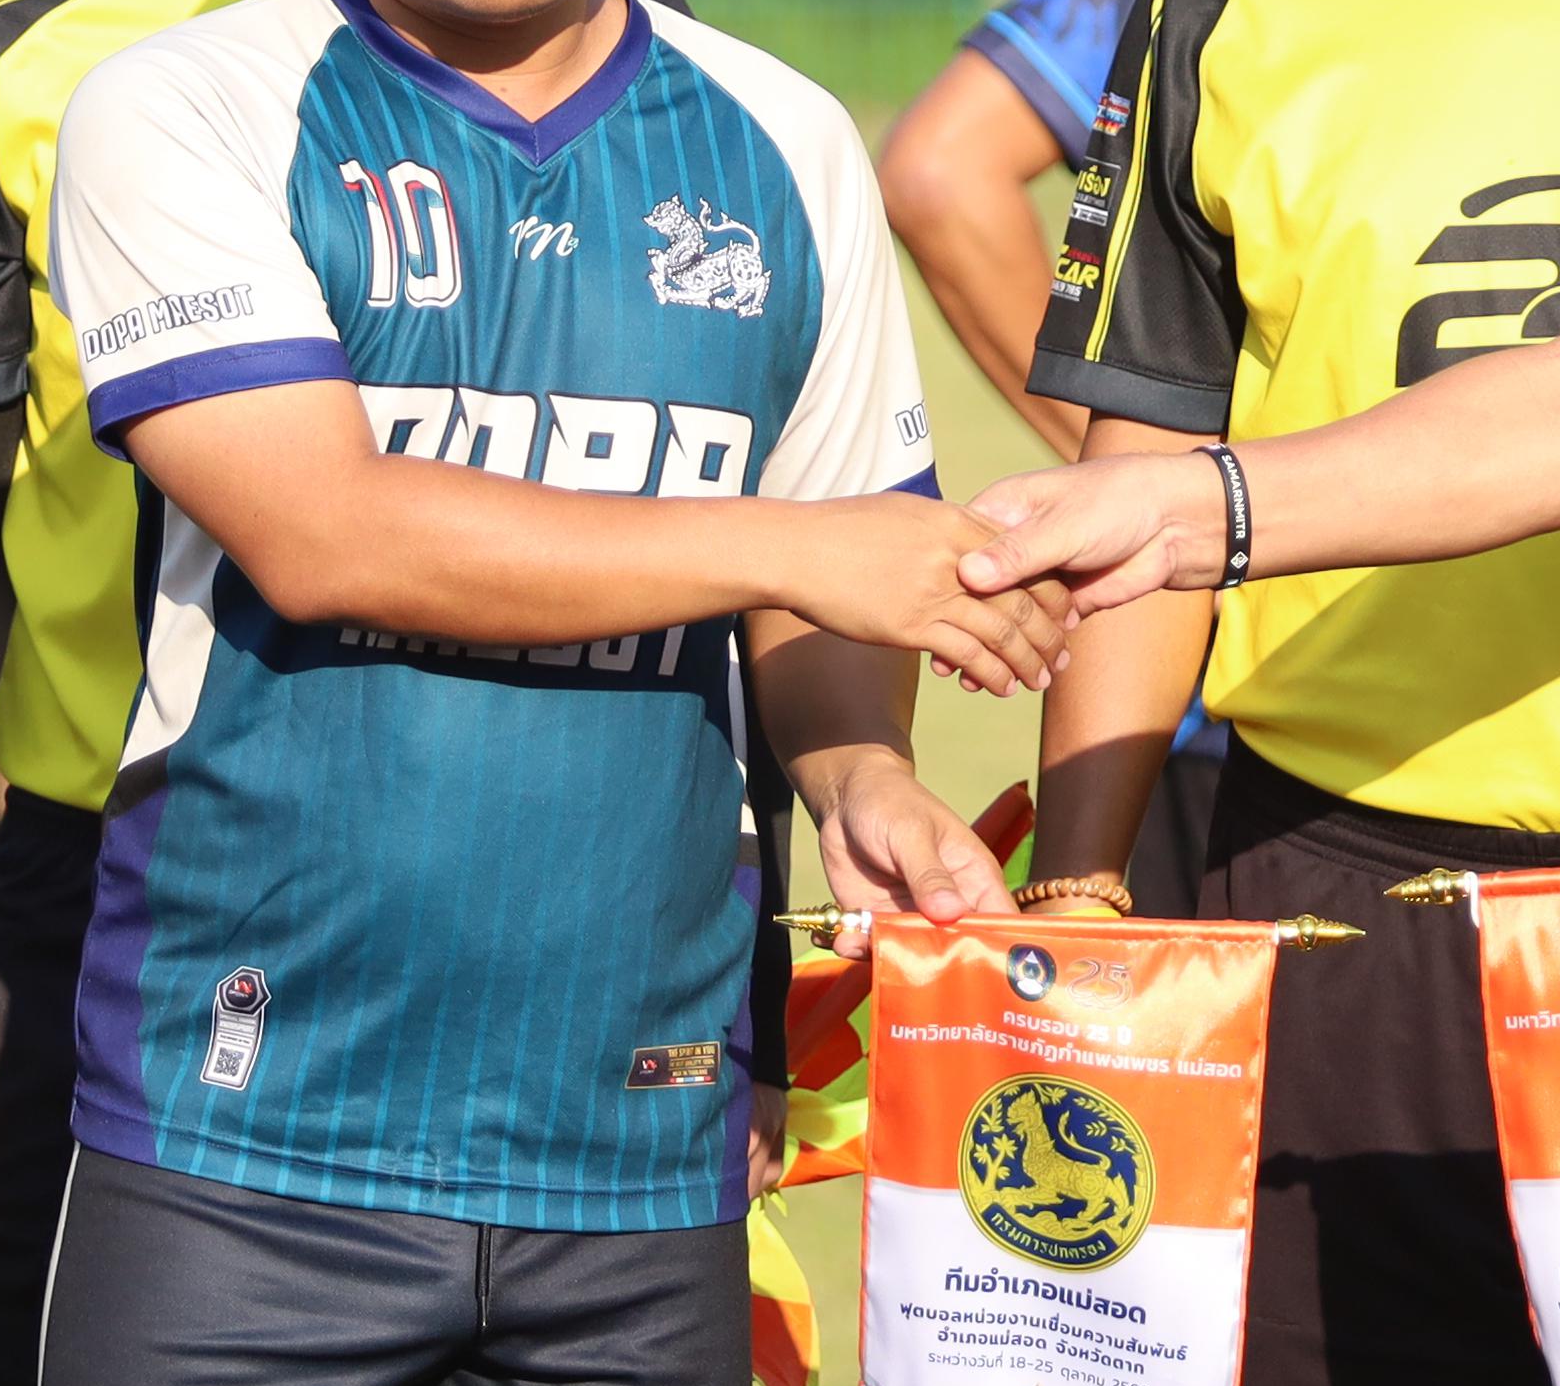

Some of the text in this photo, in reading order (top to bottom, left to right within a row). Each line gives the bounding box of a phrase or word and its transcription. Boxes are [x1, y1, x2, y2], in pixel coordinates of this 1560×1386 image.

[338, 156, 463, 309] 10
[82, 283, 254, 363] DOPA MAESOT
[895, 398, 929, 447] DO
[1221, 454, 1246, 540] SAMARNMITR
[890, 1023, 1243, 1079] มหาวิทยาลัยราชภัฏกำแพงเพชร แม่สอด
[1002, 1010, 1080, 1039] ครบรอบ
[1085, 1024, 1110, 1043] 25
[991, 1211, 1107, 1260] กรมการปกครอง
[944, 1266, 1147, 1326] ทีมอำเภอแม่สอด
[900, 1302, 1188, 1361] ฟุตบอลหน่วยงานเชื่อมความสัมพันธ์
[937, 1327, 1145, 1376] อำเภอแม่สอด จังหวัดตาก
[928, 1350, 1004, 1369] ระหว่างวันที่
[1009, 1355, 1054, 1374] 18-25
